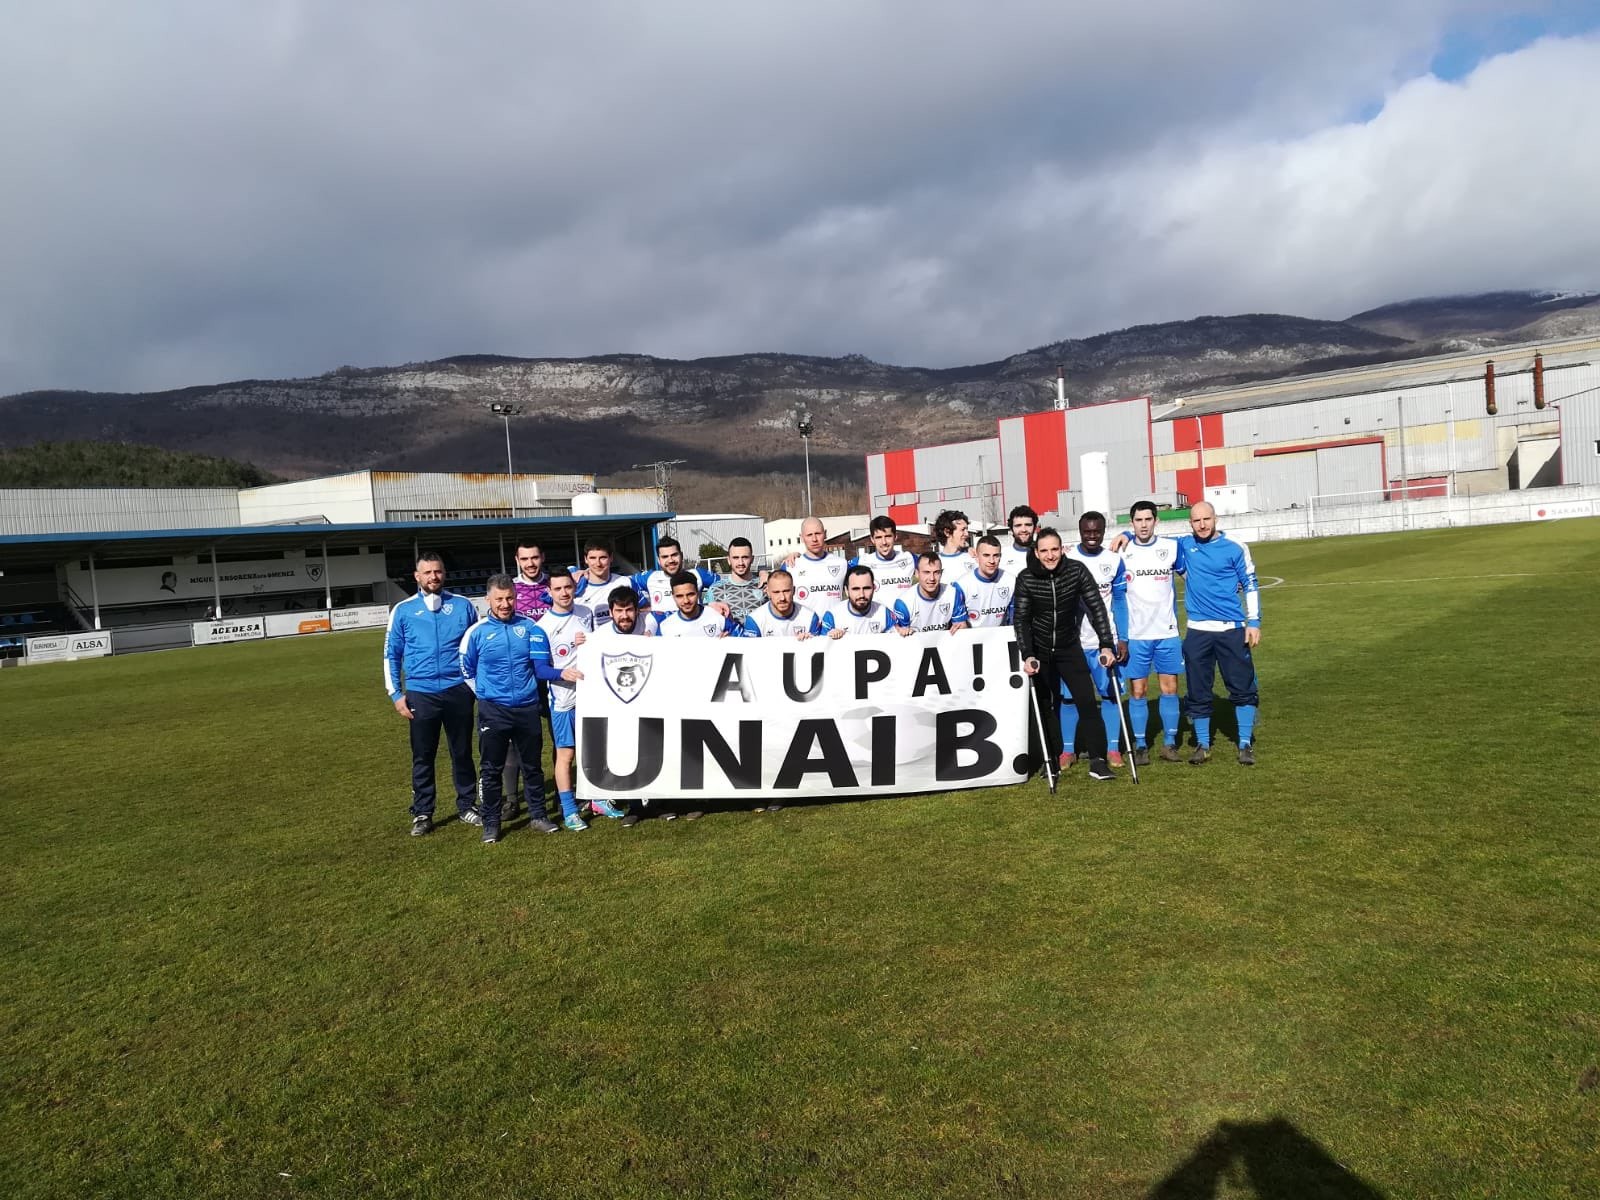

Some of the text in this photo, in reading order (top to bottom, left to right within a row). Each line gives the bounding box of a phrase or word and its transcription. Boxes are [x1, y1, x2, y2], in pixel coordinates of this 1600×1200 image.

[1136, 568, 1171, 577] SAKANA
[810, 584, 841, 593] SAKANA
[211, 624, 260, 635] ACEDESA
[76, 639, 103, 650] ALSA
[581, 708, 1028, 792] UNAI B.
